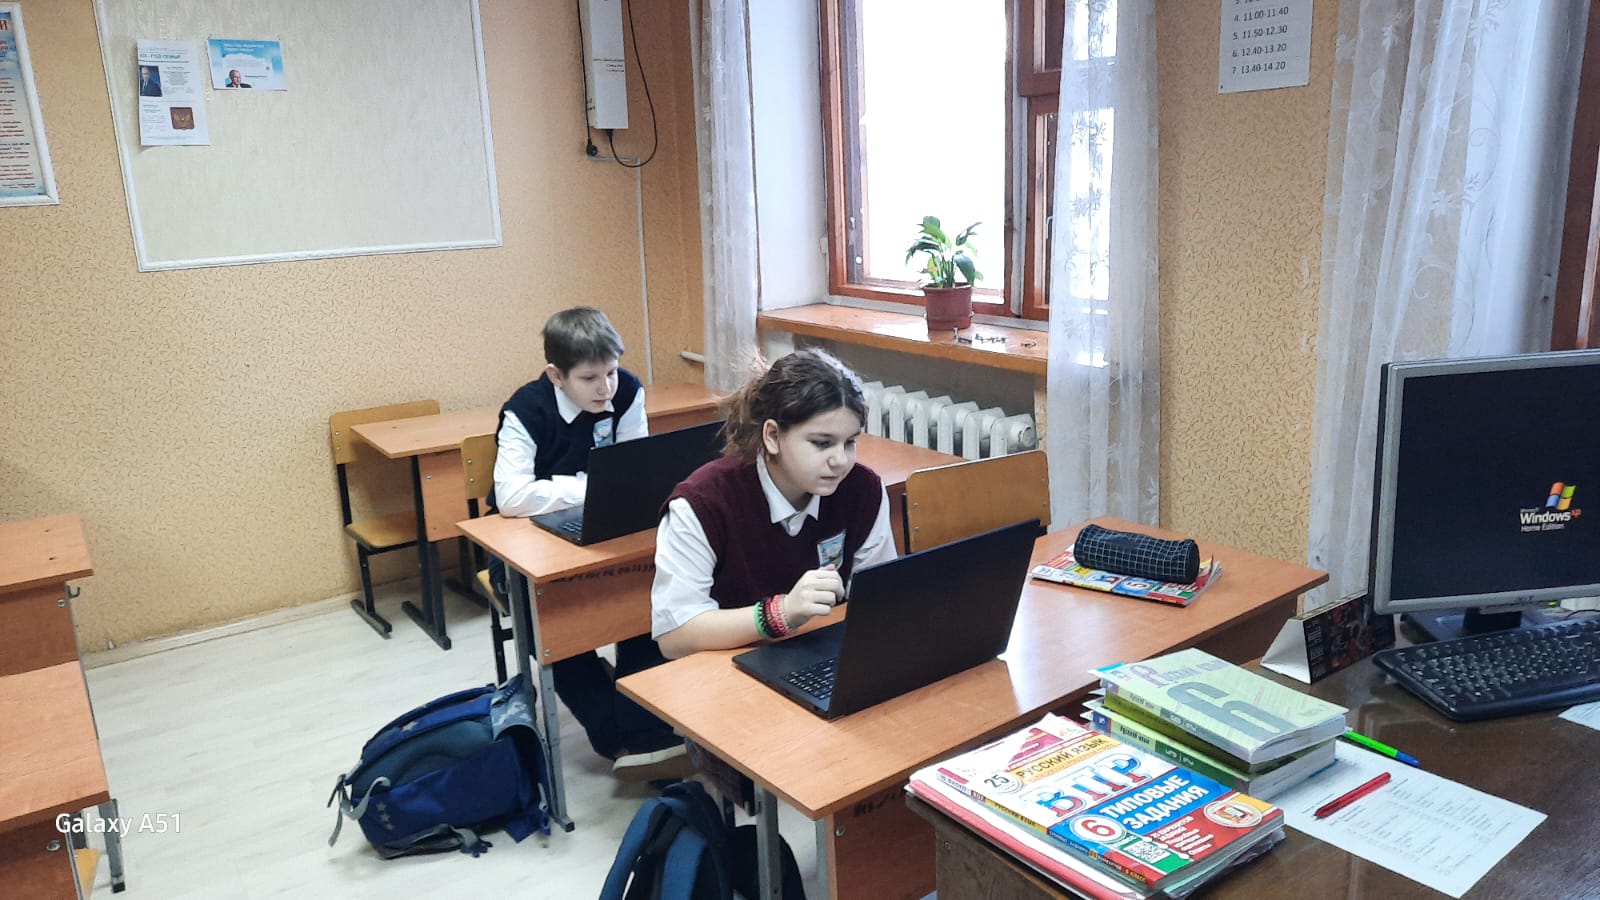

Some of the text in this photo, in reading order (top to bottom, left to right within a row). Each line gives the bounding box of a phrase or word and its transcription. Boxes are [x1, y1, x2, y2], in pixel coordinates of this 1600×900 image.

[1232, 31, 1240, 41] 5.
[1520, 511, 1571, 524] Windows
[1541, 523, 1565, 531] Edition
[1015, 738, 1108, 777] РУССКИЙ ЯЗЫК
[983, 774, 1010, 789] 25
[1026, 754, 1149, 818] ВПР
[1099, 774, 1190, 819] ТИПОВЫЕ
[1122, 785, 1210, 830] ЗАДАНИЯ
[1081, 819, 1116, 837] 6
